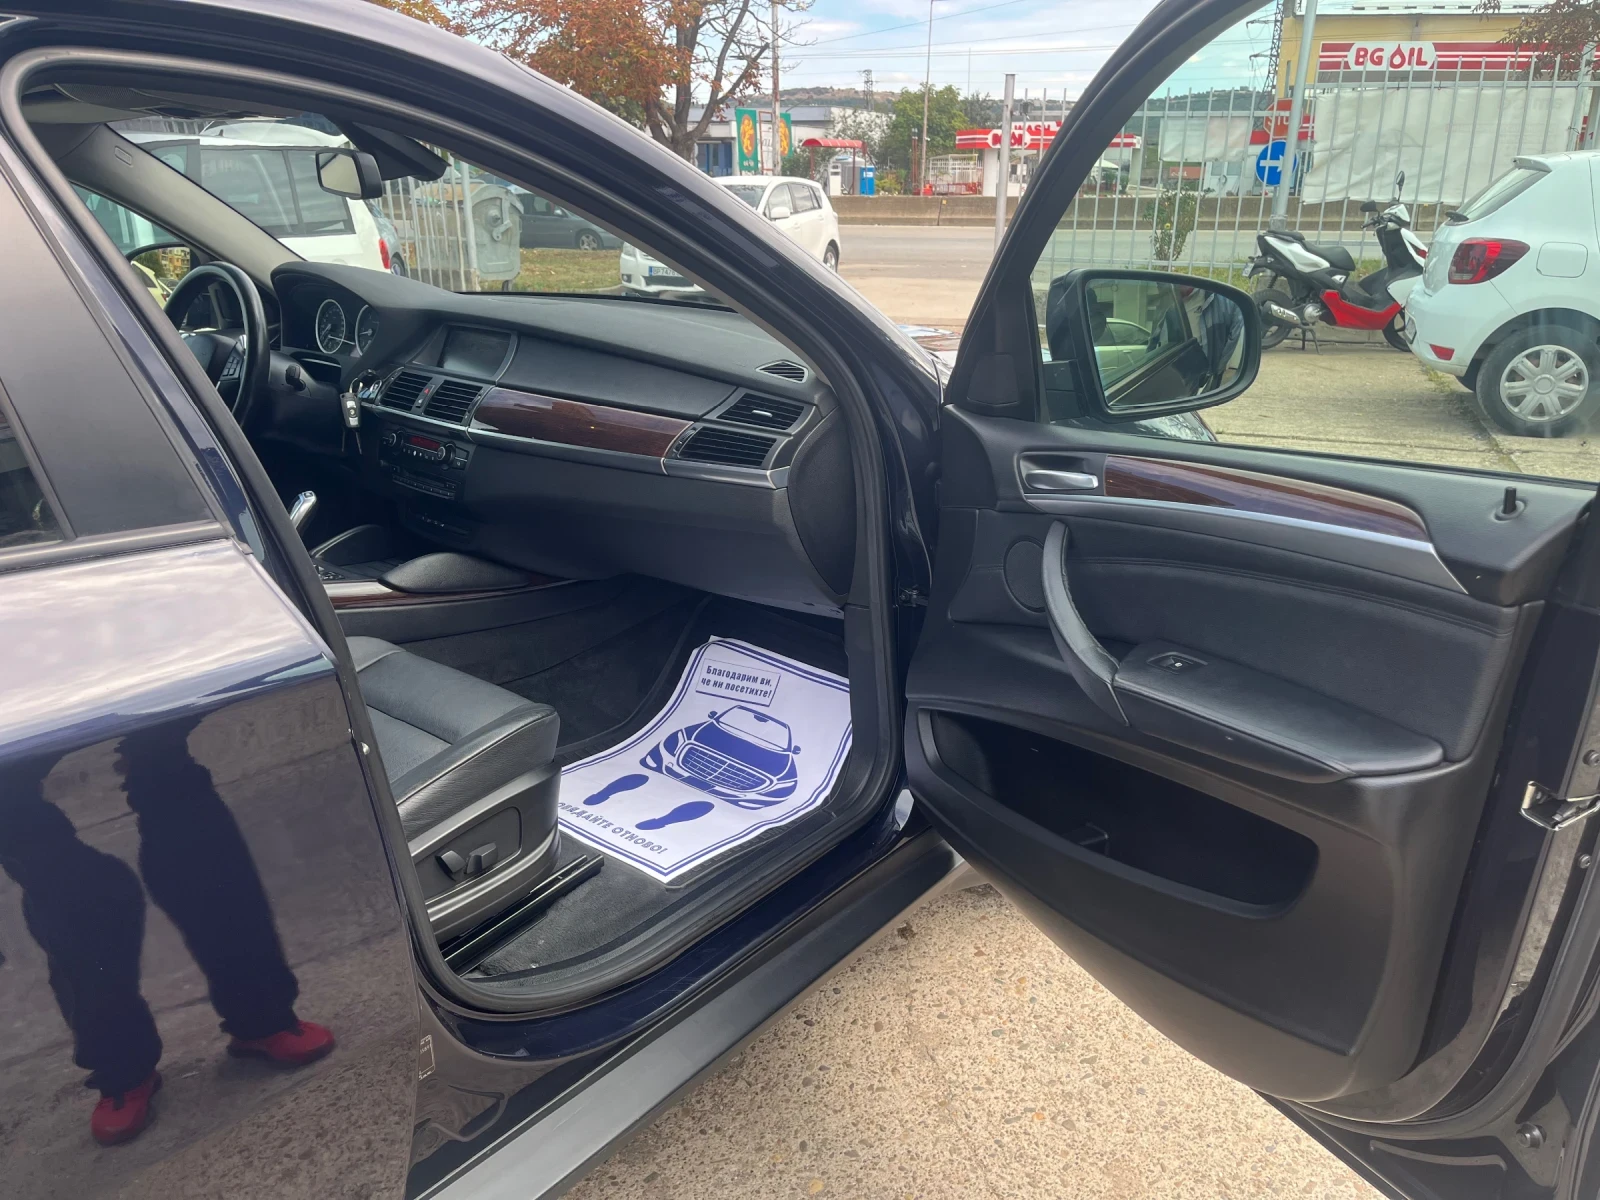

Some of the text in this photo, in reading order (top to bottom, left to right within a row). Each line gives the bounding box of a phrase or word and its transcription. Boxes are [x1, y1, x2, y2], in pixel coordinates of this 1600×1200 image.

[1354, 47, 1384, 66] BG
[706, 665, 772, 687] Благодарим ви,
[701, 677, 772, 698] че ни посетихте!
[558, 802, 668, 854] ОВЯДАЙТЕ ОТНОВО!
